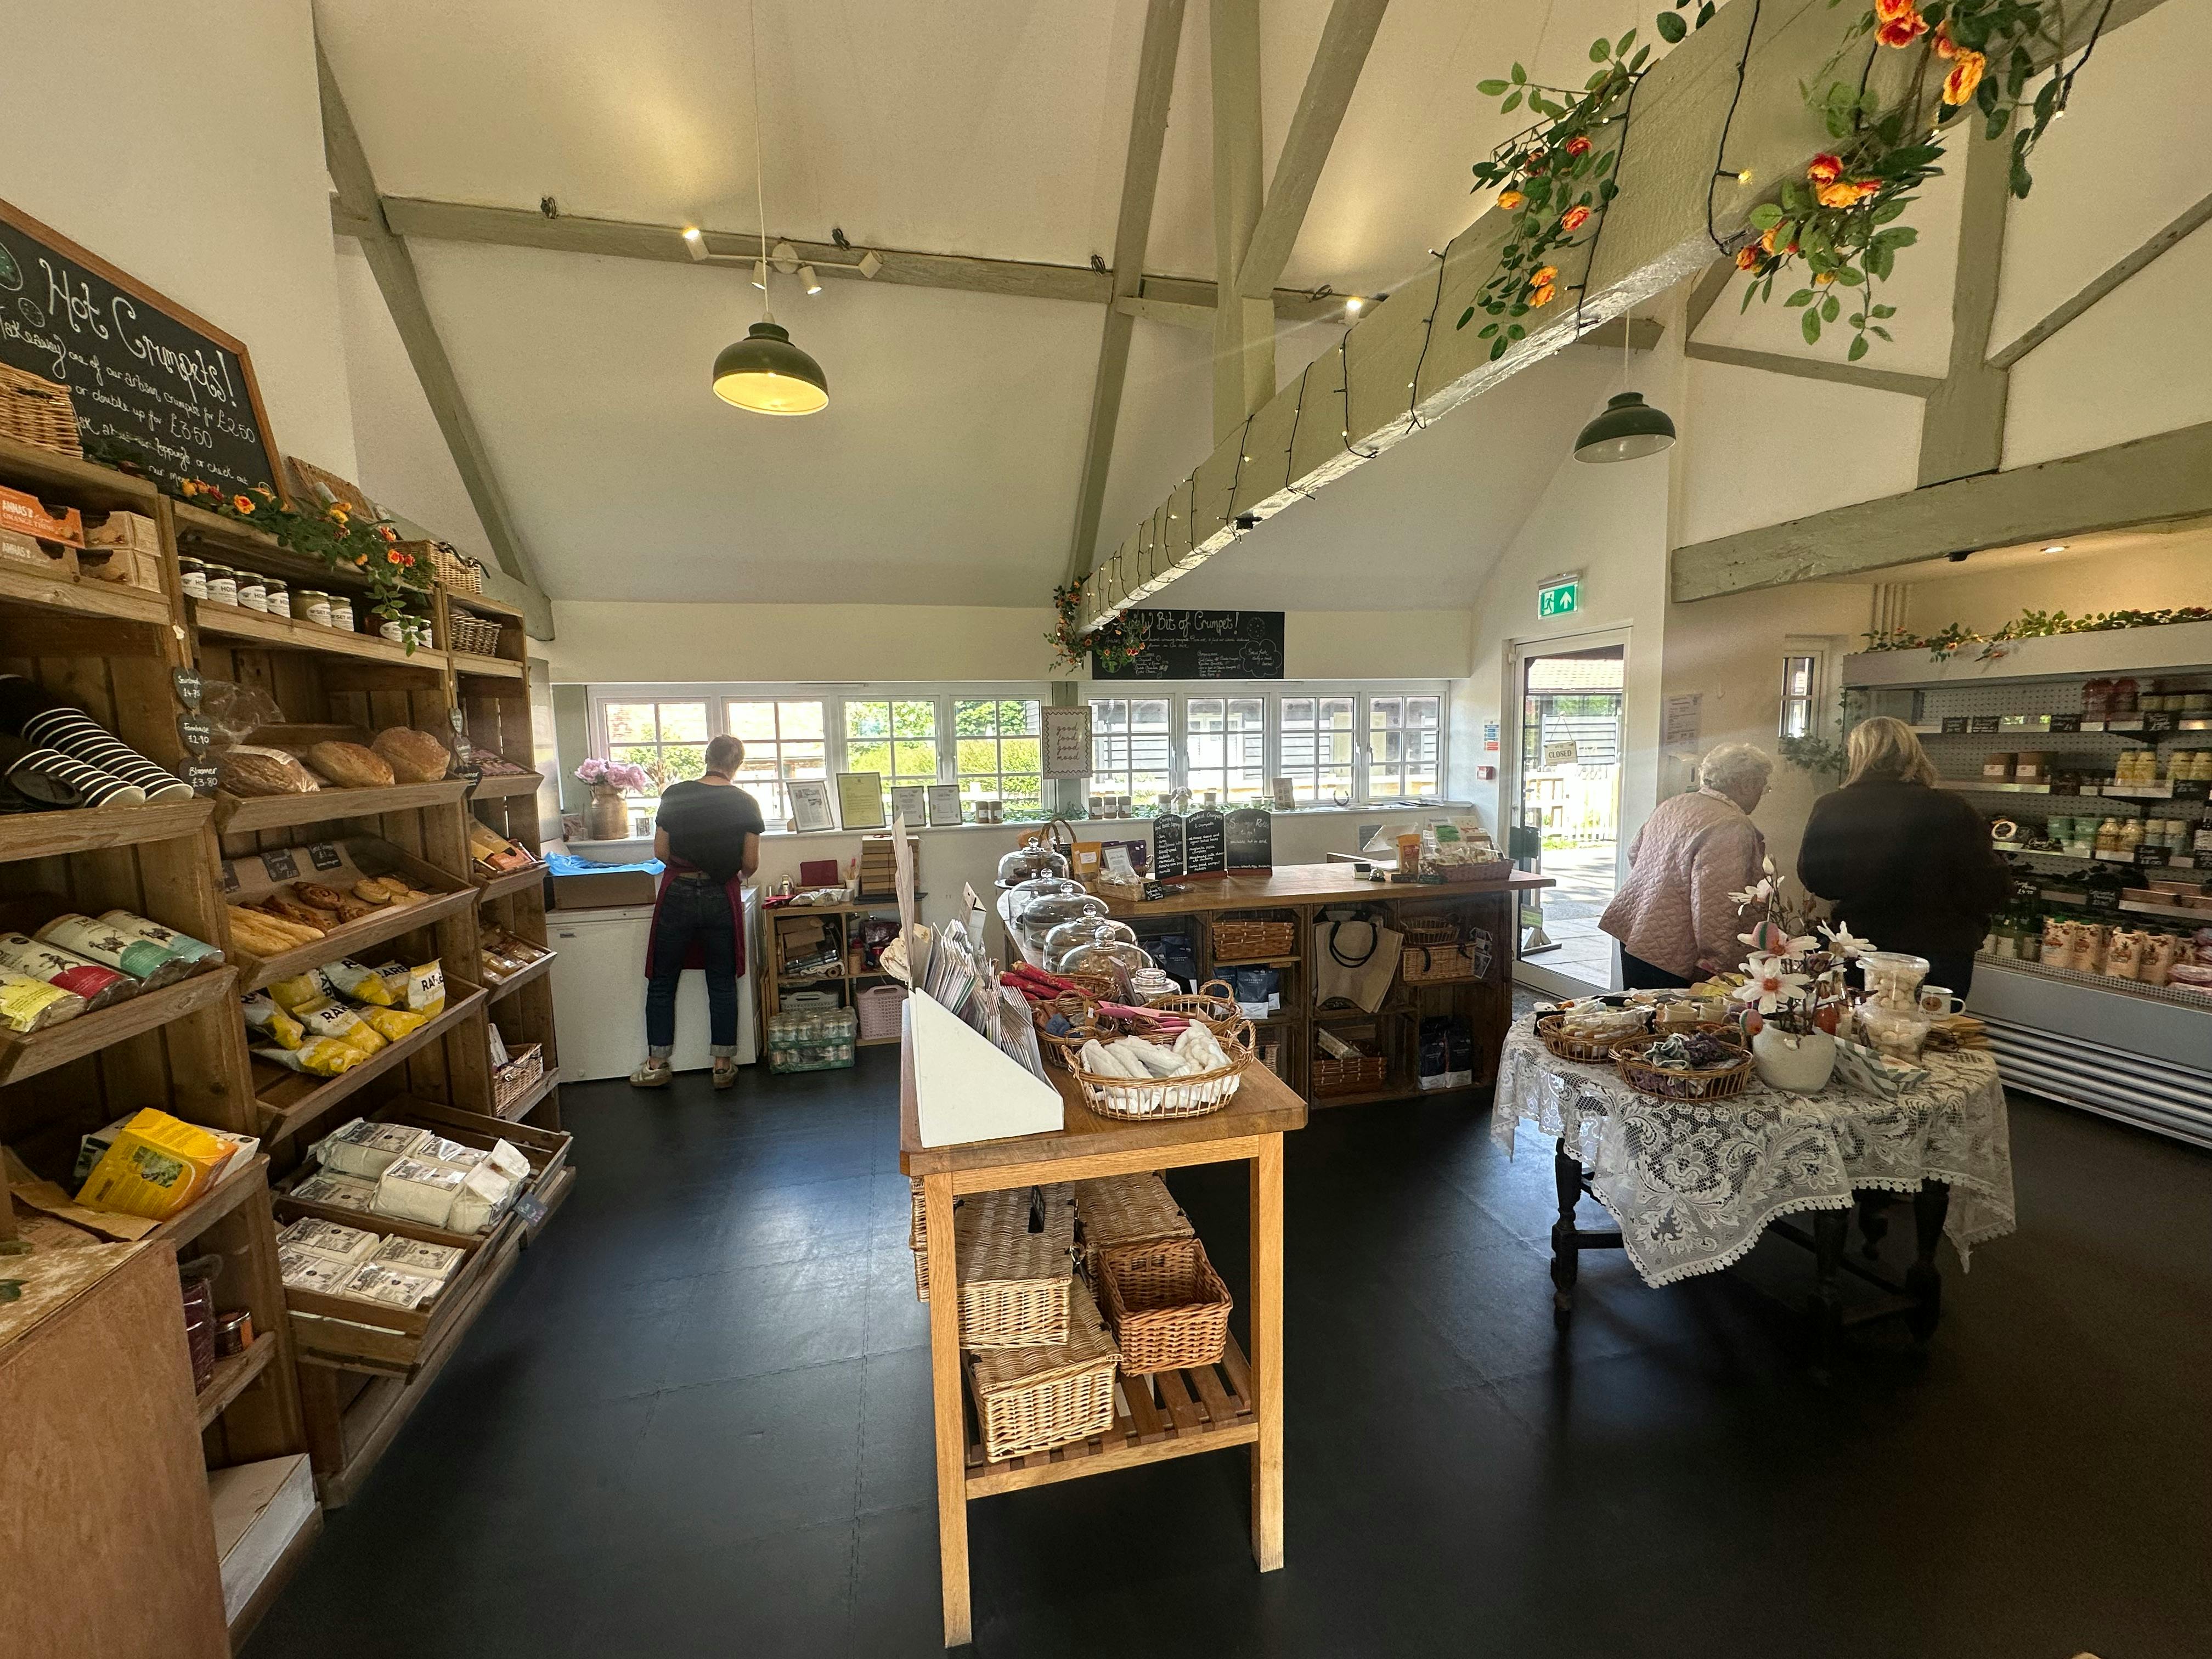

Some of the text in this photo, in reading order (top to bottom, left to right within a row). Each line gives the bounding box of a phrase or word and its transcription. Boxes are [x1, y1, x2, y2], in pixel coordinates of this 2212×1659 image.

[39, 258, 236, 407] Hot Crumpets!
[69, 352, 88, 365] one
[90, 355, 103, 386] of
[106, 367, 122, 379] our
[204, 407, 214, 427] for
[75, 386, 88, 396] or
[92, 390, 129, 411] double
[133, 408, 145, 422] up
[149, 410, 162, 431] for
[1156, 611, 1176, 631] Bit
[1178, 612, 1191, 637] of
[1194, 611, 1239, 636] Crumpet!
[1057, 722, 1079, 736] good
[1057, 732, 1077, 745] food
[1057, 742, 1080, 755] good
[1549, 750, 1572, 758] CLOSED
[1057, 752, 1080, 760] mood
[189, 767, 217, 776] Bloomer
